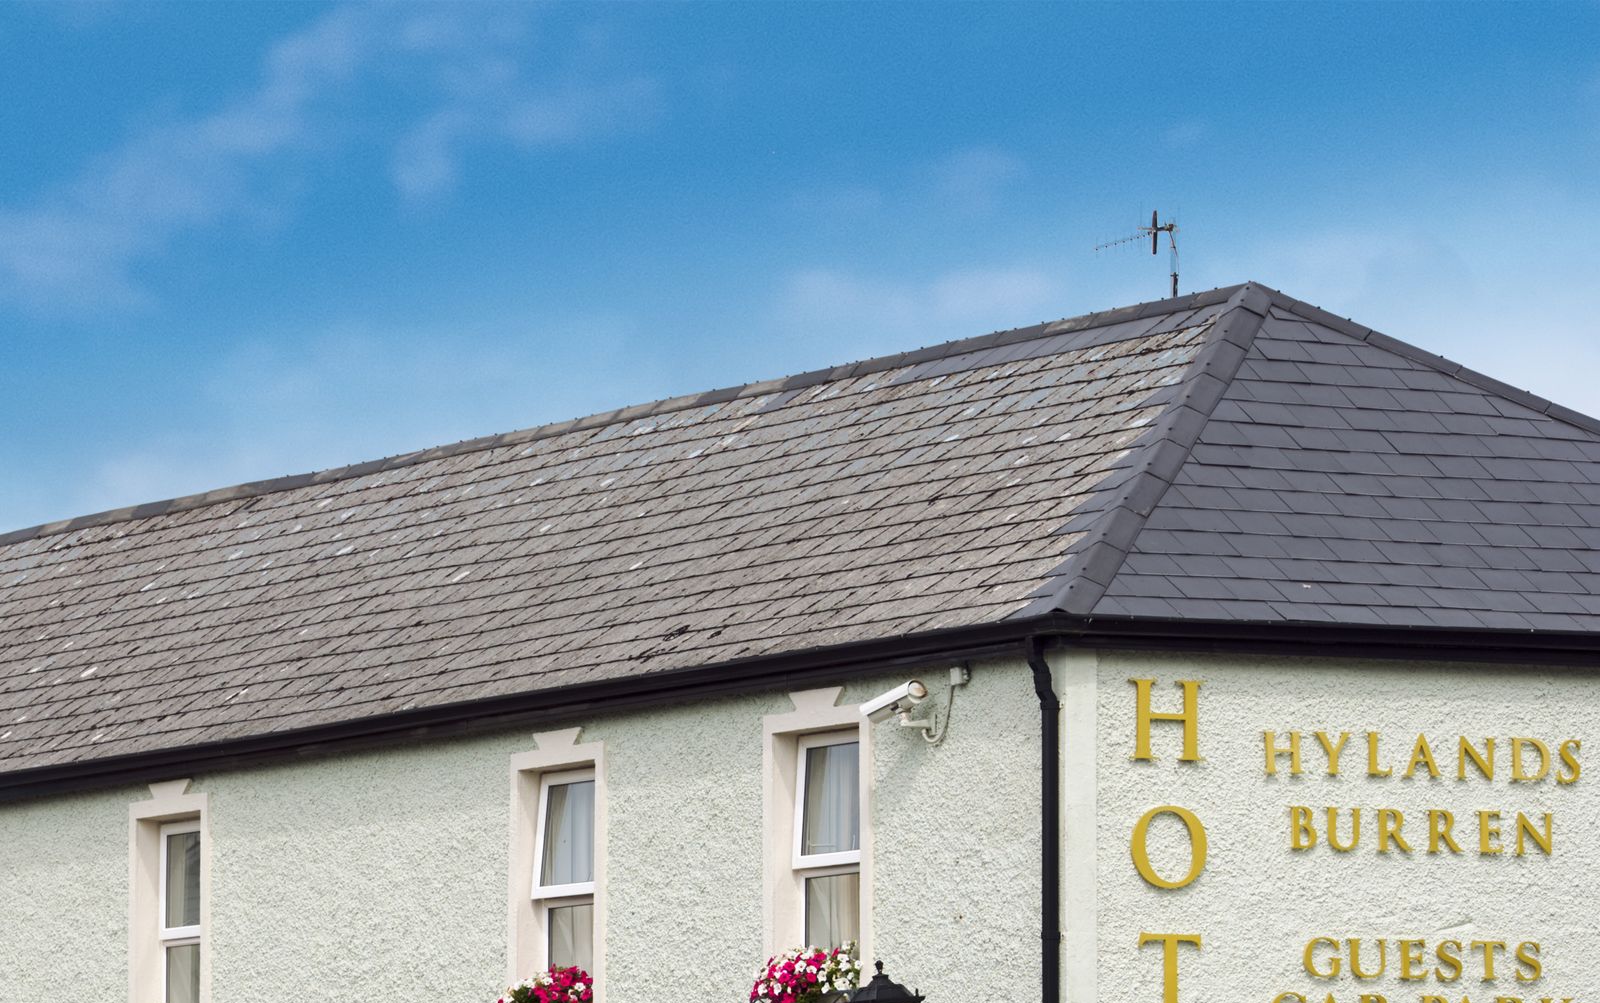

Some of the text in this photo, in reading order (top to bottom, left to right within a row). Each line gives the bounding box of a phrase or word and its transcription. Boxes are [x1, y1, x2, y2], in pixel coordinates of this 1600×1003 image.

[1262, 731, 1582, 785] HYLANDS
[1289, 806, 1553, 857] BURREN
[1302, 937, 1542, 982] GUESTS
